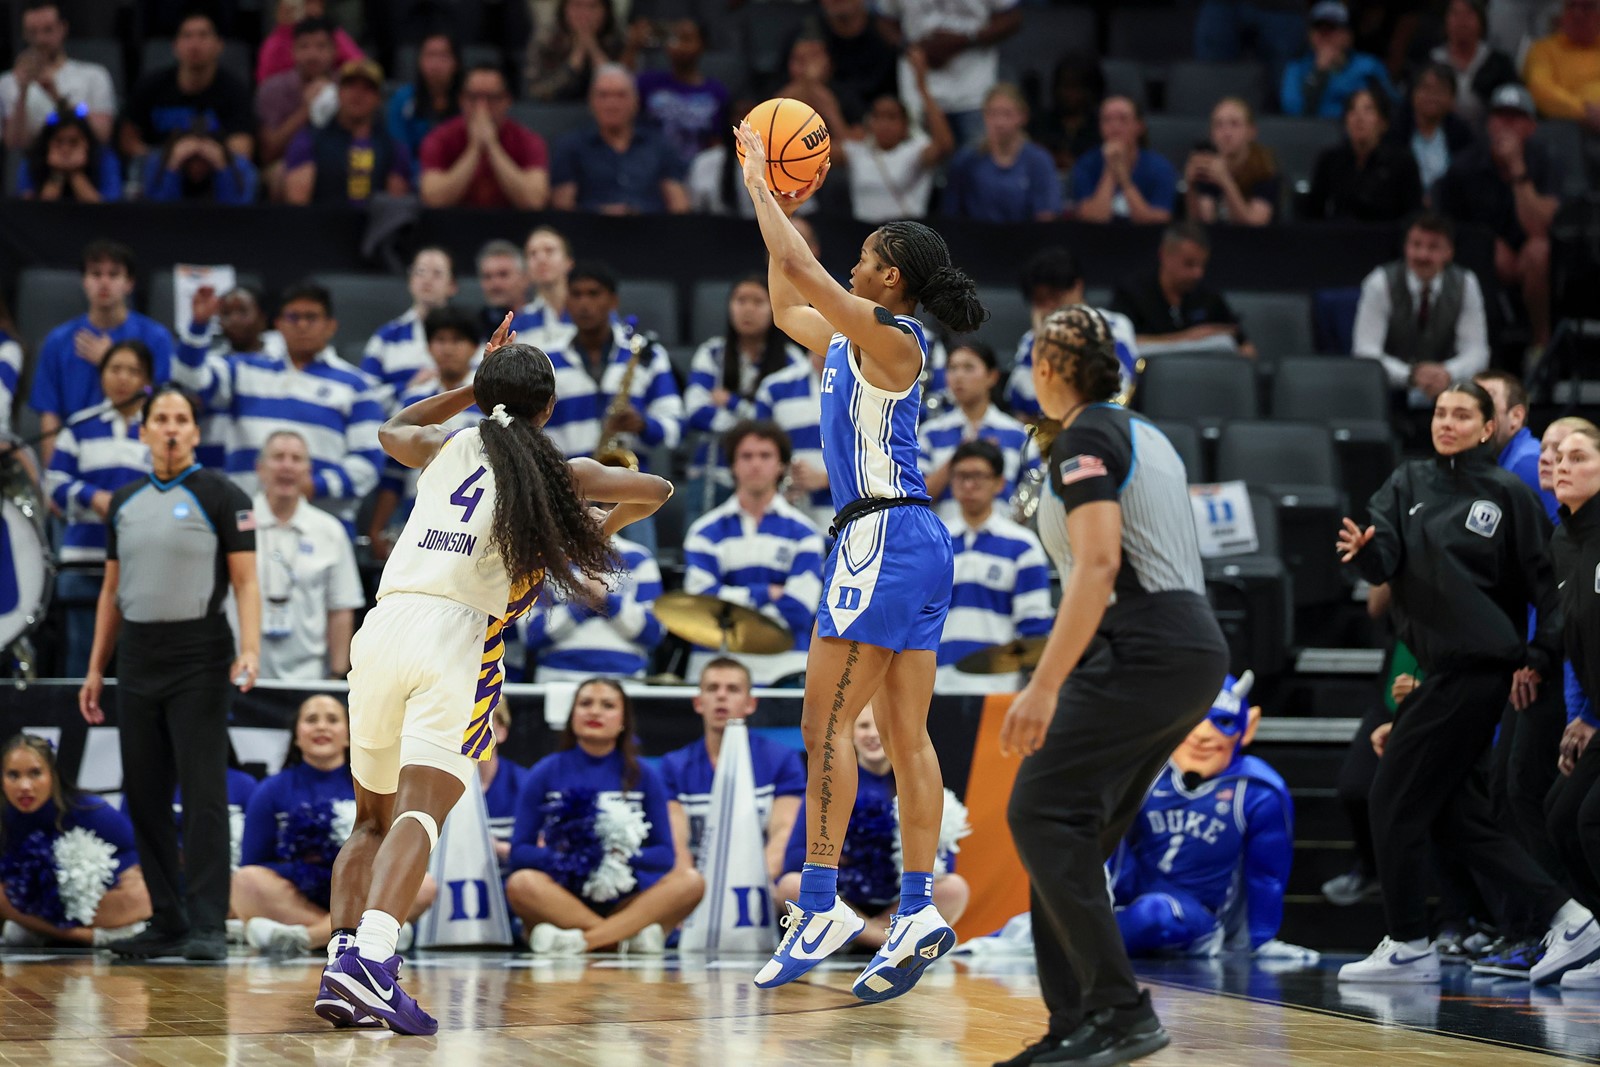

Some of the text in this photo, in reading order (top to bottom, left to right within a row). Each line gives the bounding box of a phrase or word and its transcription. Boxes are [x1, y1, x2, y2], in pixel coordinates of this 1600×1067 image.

[450, 465, 487, 523] 4
[417, 528, 478, 557] JOHNSON
[834, 585, 863, 610] D
[846, 653, 858, 667] the
[836, 667, 852, 691] valley
[834, 690, 845, 702] of
[824, 712, 838, 741] shadow
[823, 741, 835, 753] of
[821, 781, 832, 797] will
[820, 796, 832, 813] fear
[820, 814, 827, 825] no
[1146, 808, 1227, 845] DUKE
[820, 825, 830, 840] evil
[810, 842, 835, 857] 222
[1157, 834, 1185, 874] 1
[446, 879, 490, 921] D
